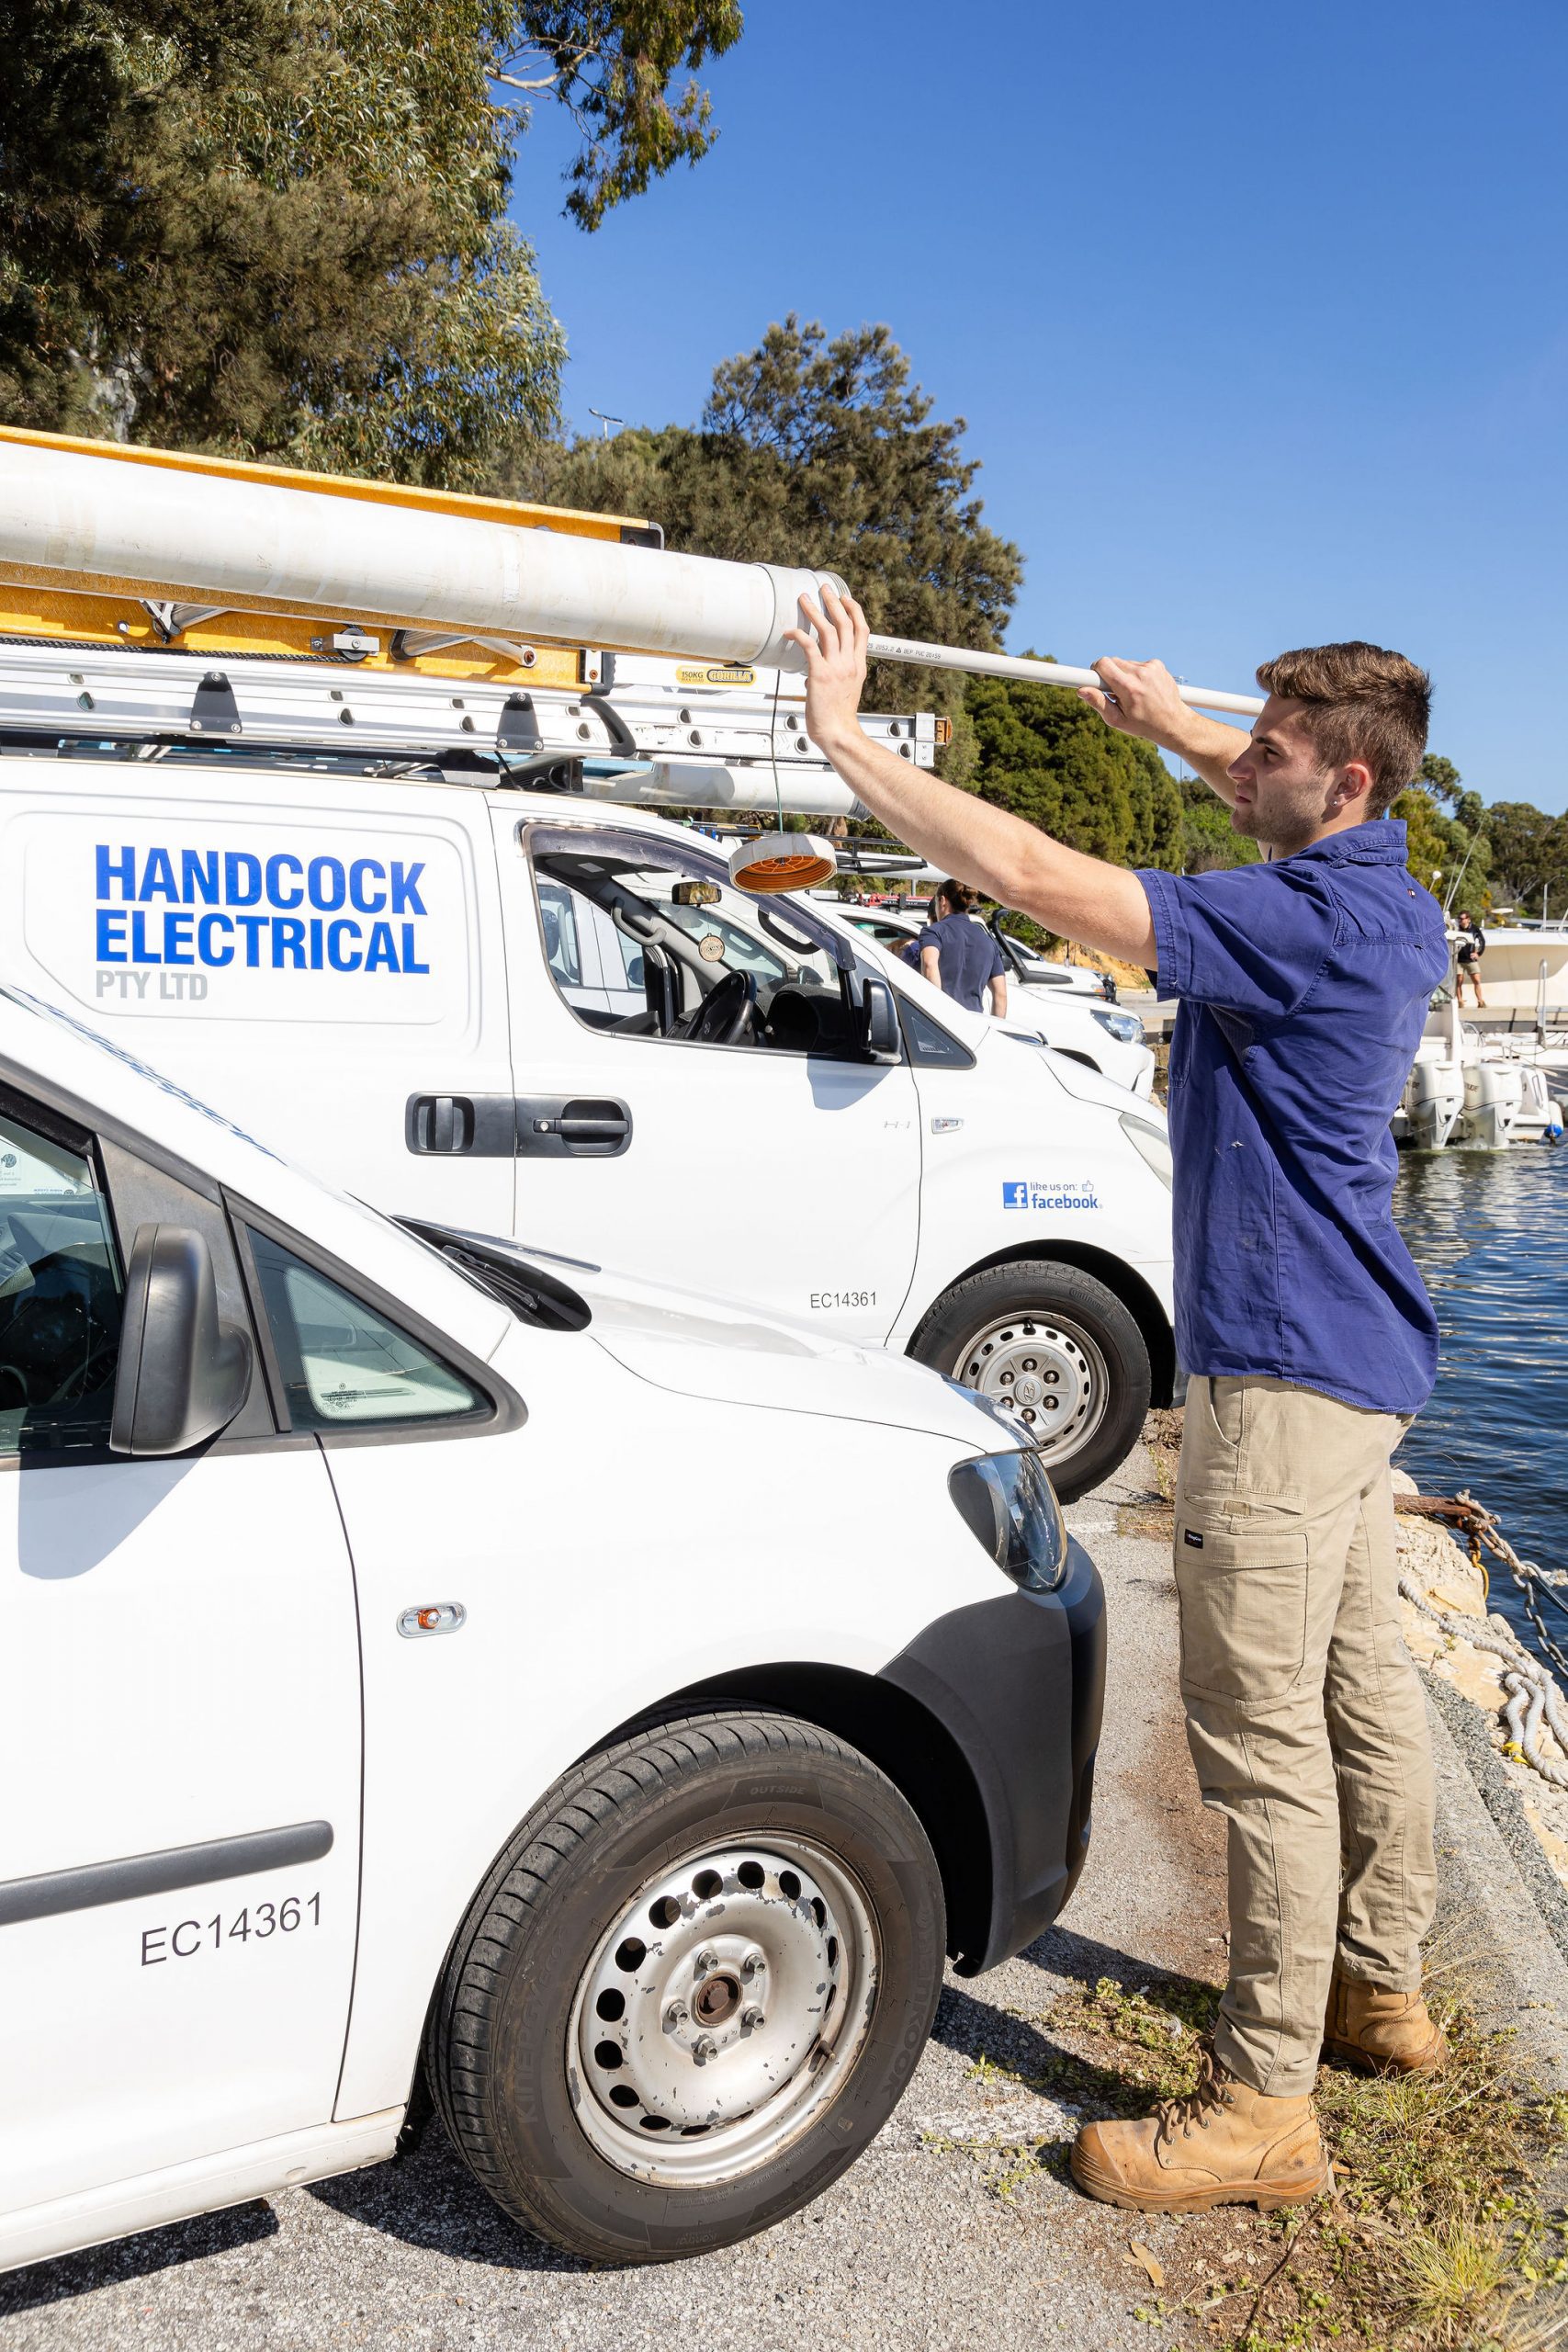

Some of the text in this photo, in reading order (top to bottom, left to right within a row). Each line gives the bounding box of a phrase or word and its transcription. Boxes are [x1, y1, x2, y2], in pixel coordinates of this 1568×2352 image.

[682, 670, 752, 683] 150KG GORILLA
[96, 844, 428, 916] HANDCOCK
[96, 909, 430, 974] ELECTRICAL
[96, 970, 208, 1001] PTY LTD
[1030, 1182, 1047, 1191] like
[1031, 1193, 1099, 1209] facebook
[810, 1291, 876, 1308] EC14361
[750, 1785, 808, 1795] OUTSIDE
[141, 1891, 321, 1966] EC14361
